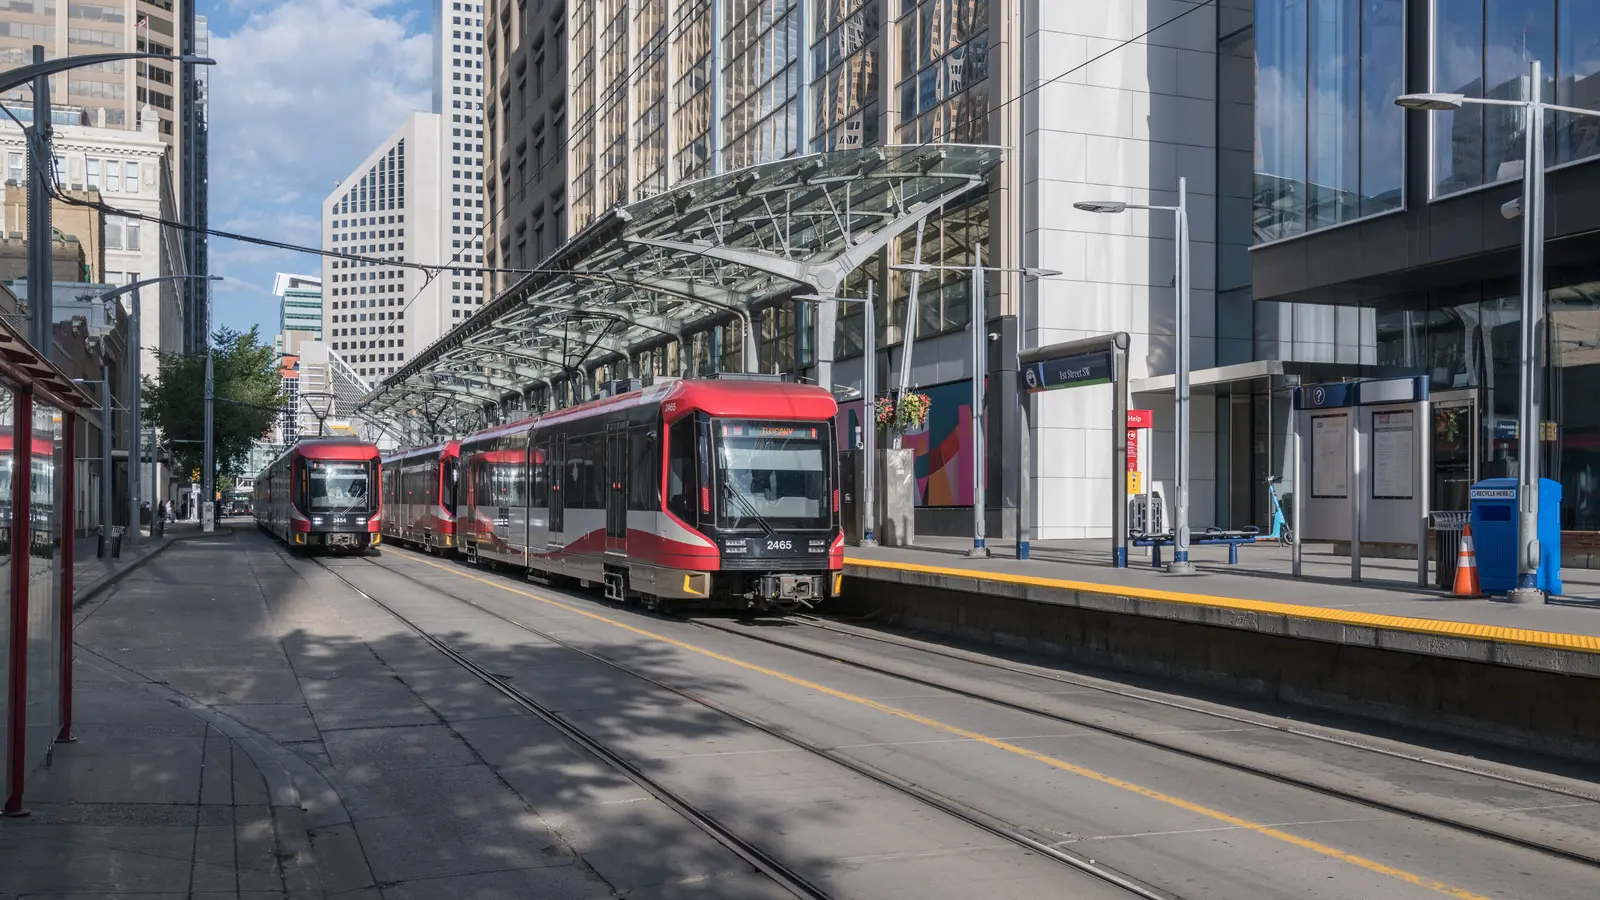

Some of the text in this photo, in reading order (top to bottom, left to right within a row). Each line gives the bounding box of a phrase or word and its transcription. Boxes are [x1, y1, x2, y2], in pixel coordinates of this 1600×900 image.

[1059, 366, 1091, 380] 1st Street SW
[761, 428, 794, 436] TUSCANY
[767, 540, 792, 550] 2465
